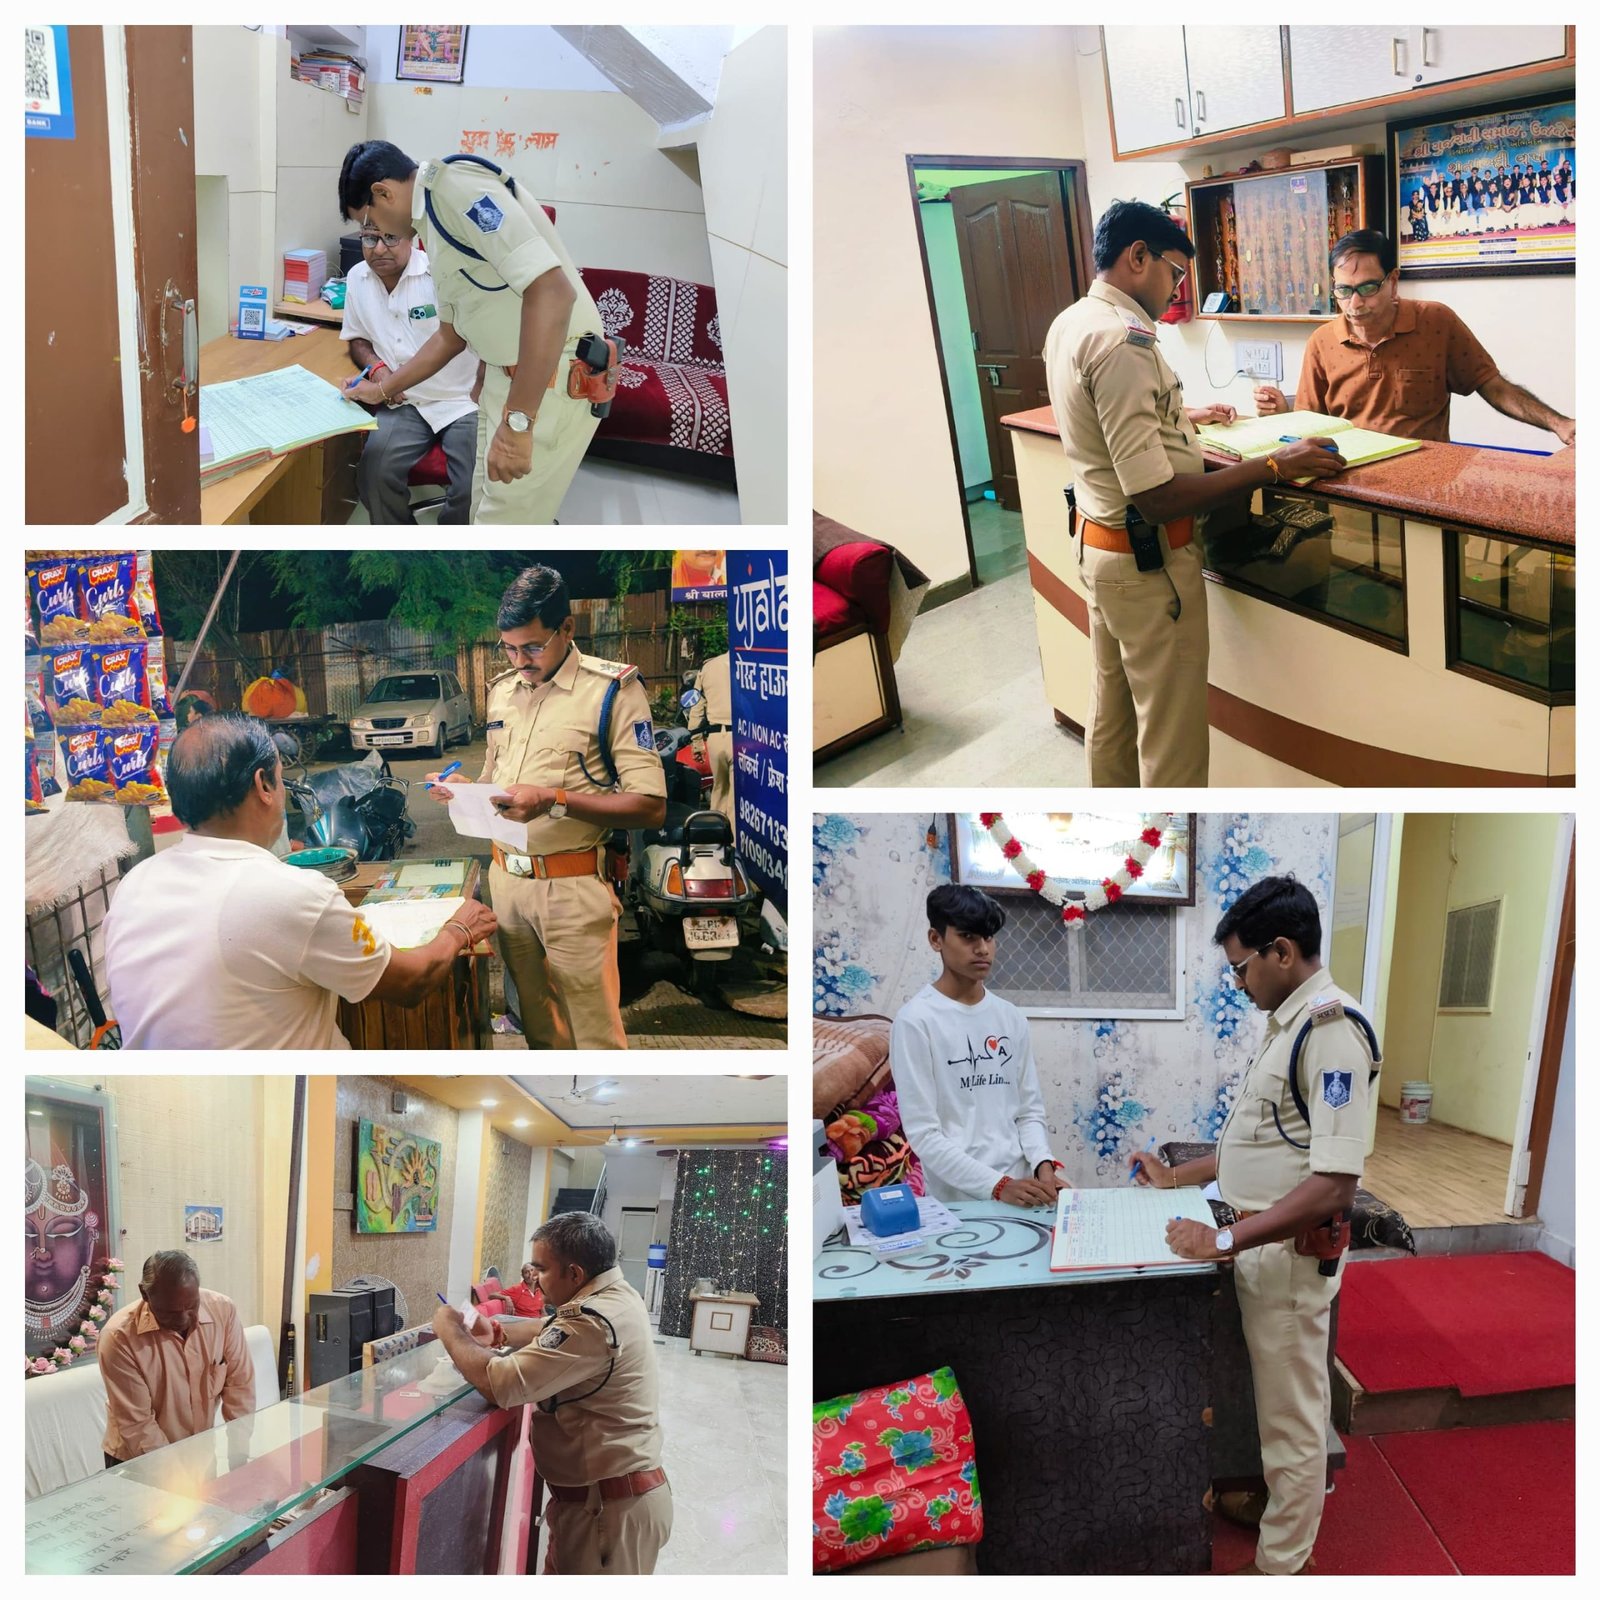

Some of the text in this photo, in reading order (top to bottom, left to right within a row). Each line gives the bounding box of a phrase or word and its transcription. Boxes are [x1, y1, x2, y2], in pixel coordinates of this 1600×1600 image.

[41, 568, 63, 581] CRAX
[91, 564, 114, 577] CRAX
[37, 581, 74, 614] Curls
[86, 579, 125, 612] Curls
[684, 588, 700, 600] श्री
[57, 653, 78, 665] CRAX
[105, 652, 126, 664] CRAX
[100, 667, 136, 698] Curls
[735, 652, 788, 701] गेस्ट हाऊ
[737, 718, 747, 736] AC
[751, 722, 768, 745] NON
[769, 729, 782, 751] AC
[67, 750, 105, 776] Curls
[112, 750, 147, 779] Curls
[737, 747, 759, 780] लॉकर्स
[998, 1045, 1008, 1057] A
[972, 1074, 987, 1086] Life
